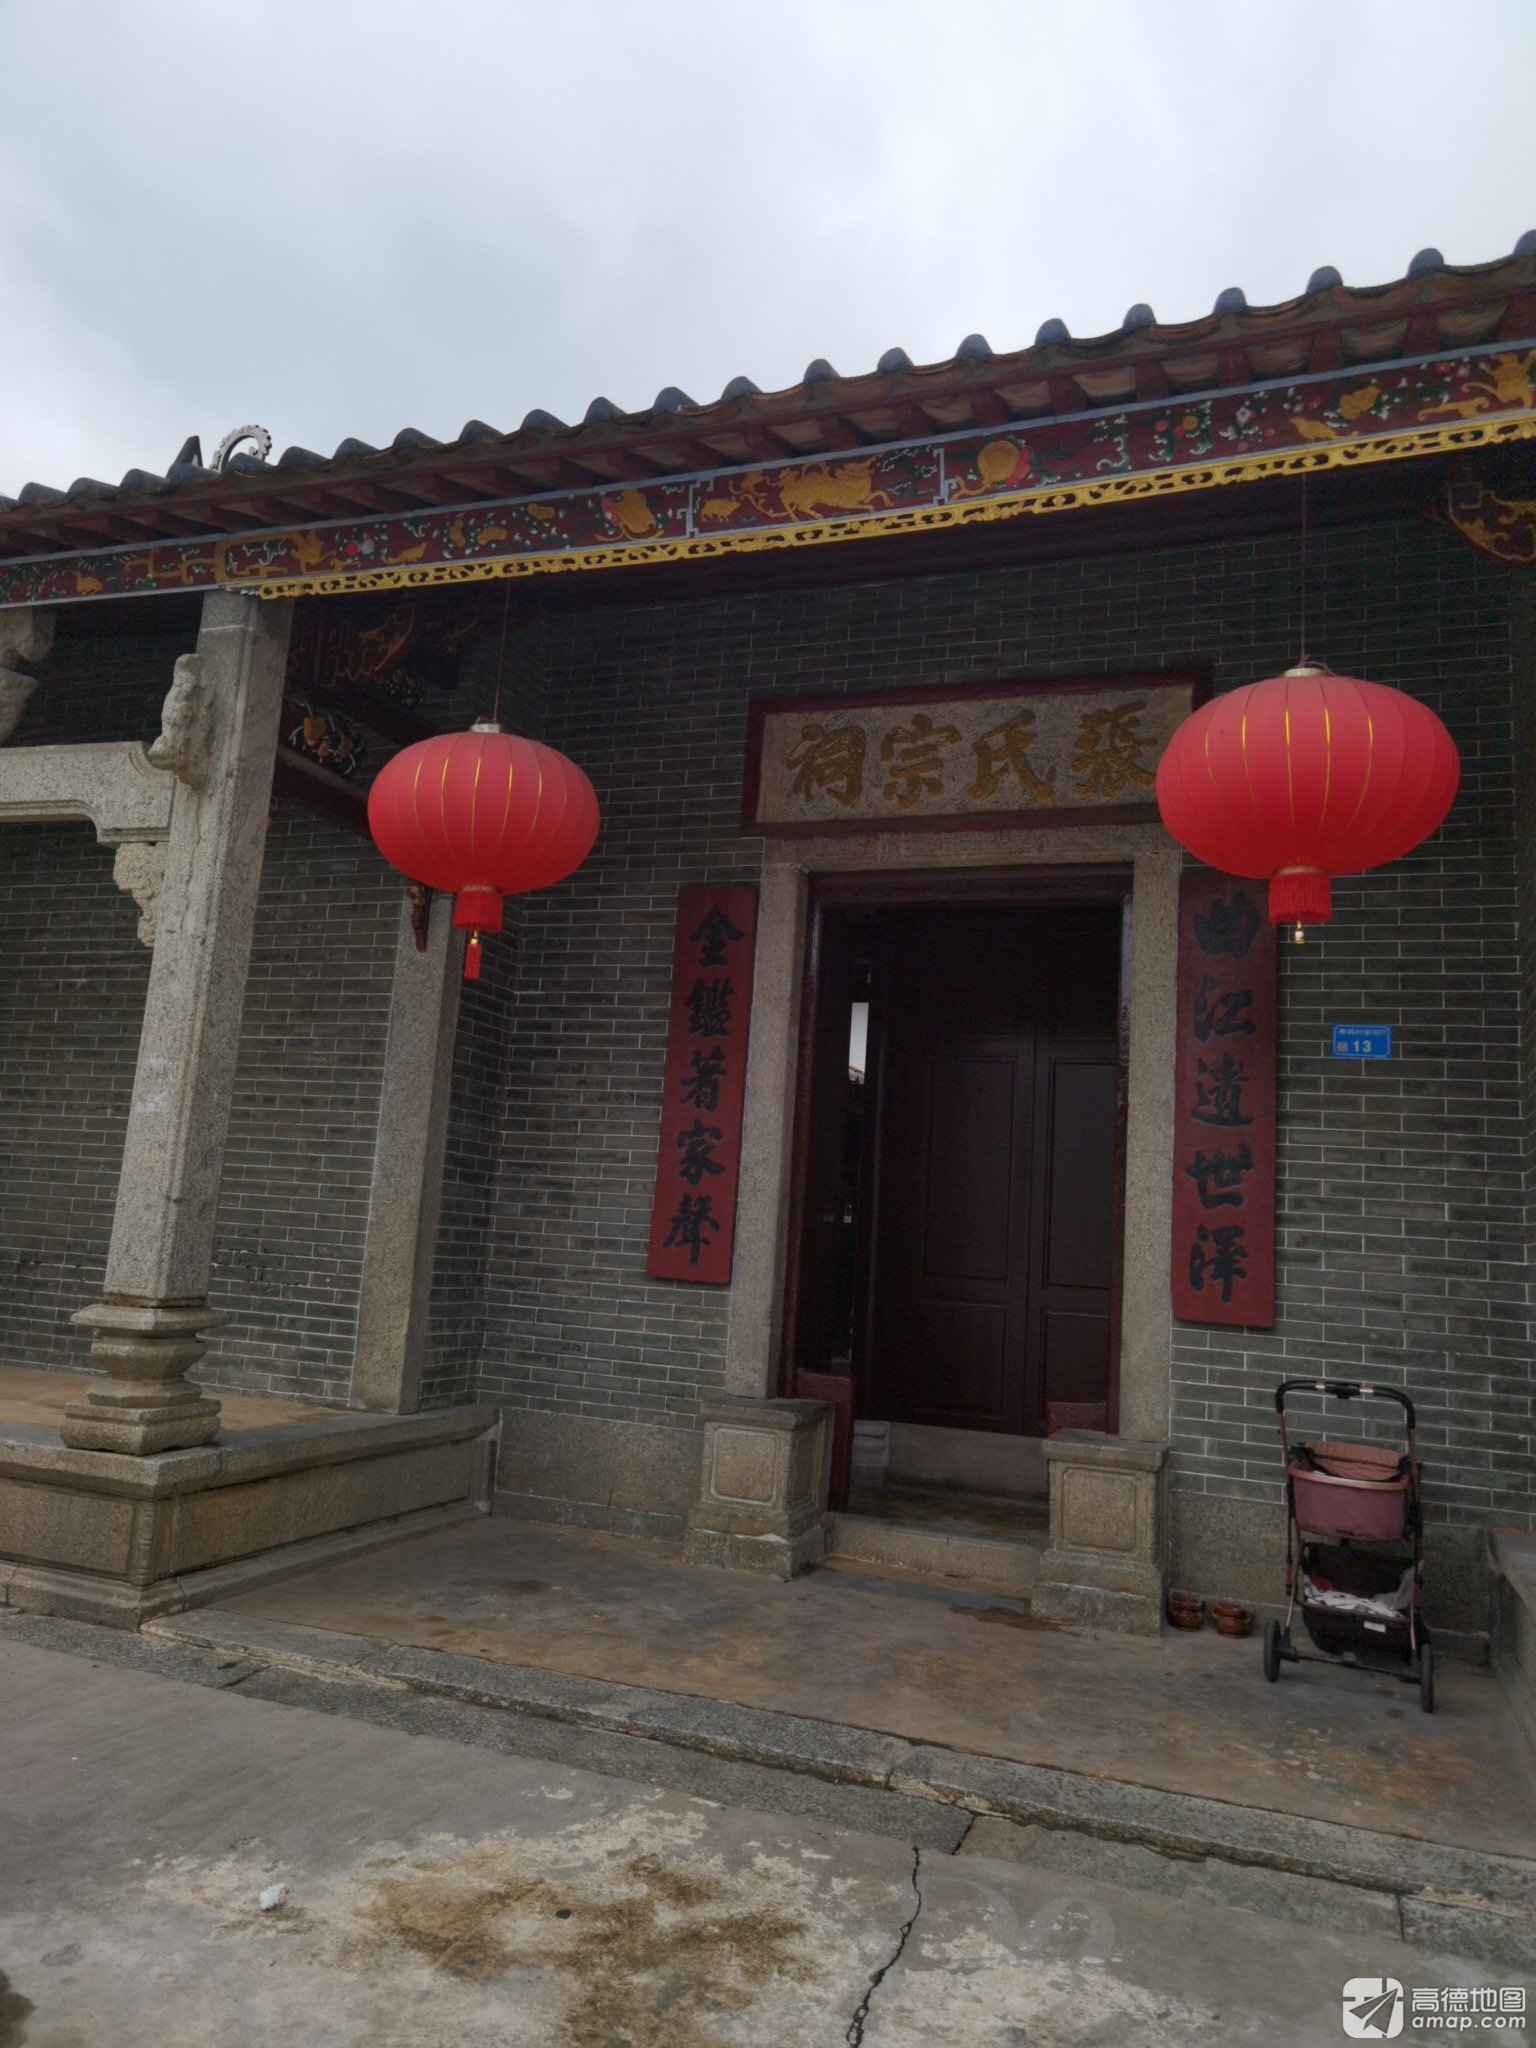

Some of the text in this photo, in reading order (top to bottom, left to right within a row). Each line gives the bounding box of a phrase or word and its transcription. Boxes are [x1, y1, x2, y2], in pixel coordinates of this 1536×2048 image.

[1184, 890, 1261, 1303] 曲江遺世澤
[1352, 1040, 1372, 1053] 13
